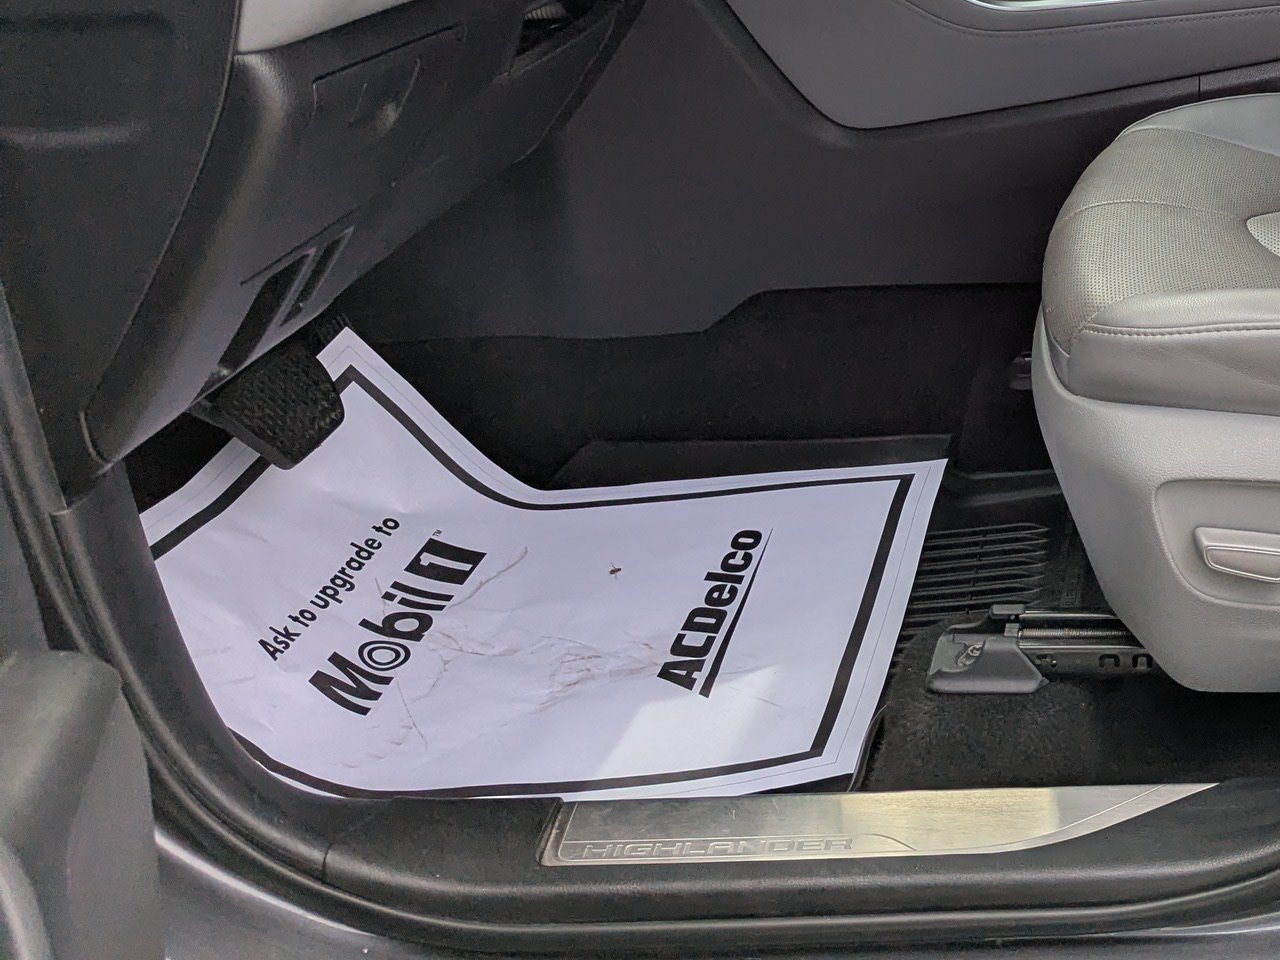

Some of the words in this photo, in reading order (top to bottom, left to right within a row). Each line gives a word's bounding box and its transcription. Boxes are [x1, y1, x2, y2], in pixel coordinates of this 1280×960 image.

[258, 626, 300, 661] Ask
[288, 608, 317, 628] to
[309, 537, 382, 610] upgrade
[372, 516, 400, 537] to
[308, 581, 455, 716] Mobil
[656, 529, 763, 691] ACDelco
[581, 838, 854, 858] HIGHLANDER
